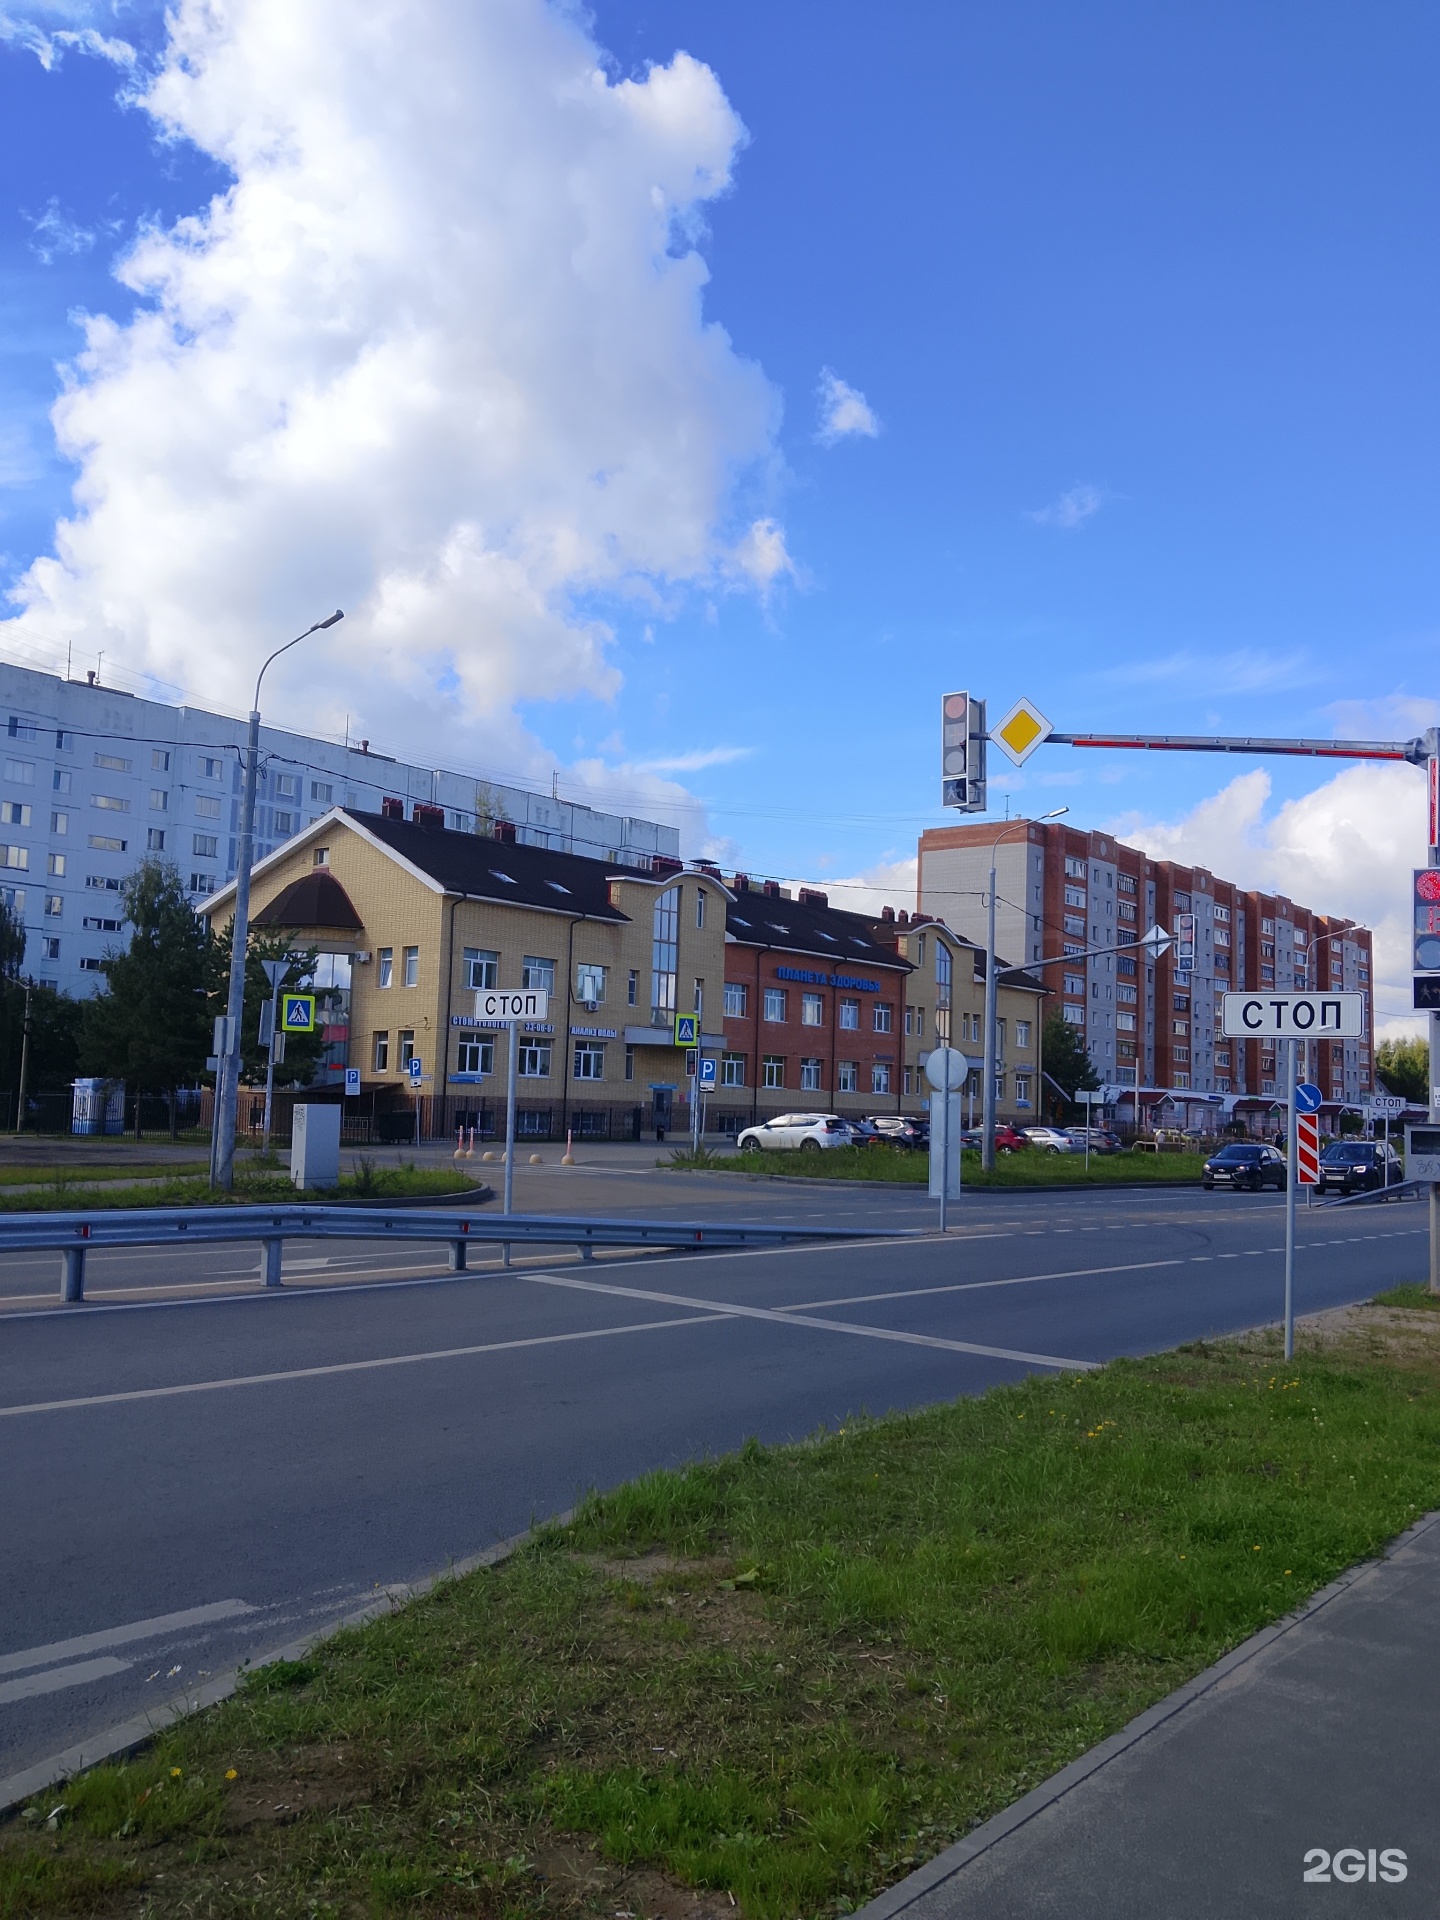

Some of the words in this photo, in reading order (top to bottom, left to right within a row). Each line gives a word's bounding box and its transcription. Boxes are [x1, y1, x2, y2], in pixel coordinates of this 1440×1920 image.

[777, 966, 827, 985] ПЛАНЕТА
[830, 973, 881, 992] ЗДОРОВЬЯ
[485, 995, 537, 1016] СТОП
[1242, 1000, 1342, 1030] СТОП
[1375, 1097, 1401, 1108] СТОП
